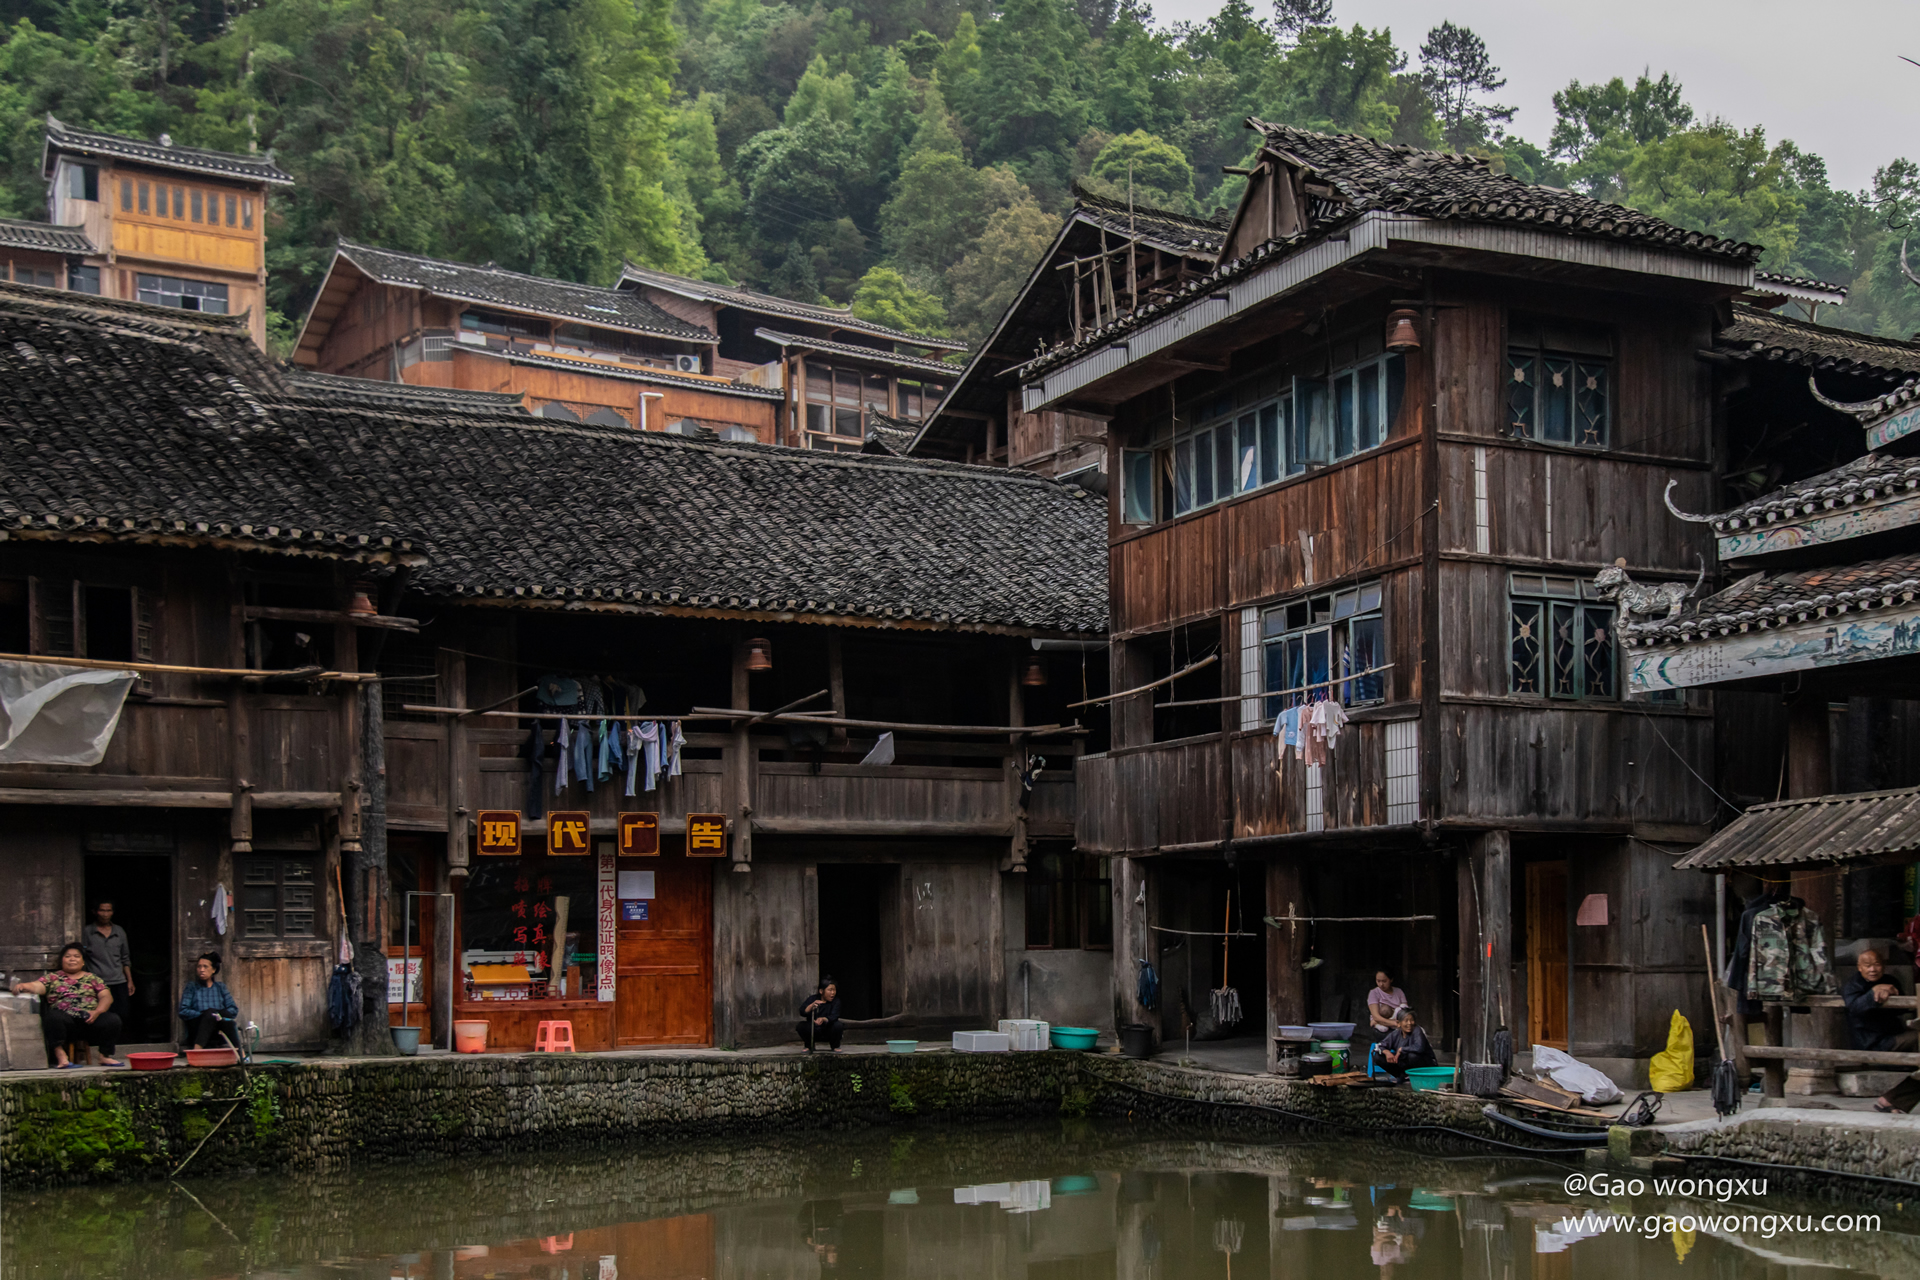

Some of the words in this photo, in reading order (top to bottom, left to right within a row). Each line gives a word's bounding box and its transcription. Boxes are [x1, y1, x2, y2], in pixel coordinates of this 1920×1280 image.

[483, 821, 723, 848] 现代广告
[511, 899, 552, 918] 喷绘
[513, 923, 547, 944] 写真
[600, 854, 615, 990] 第二代身份证照像点
